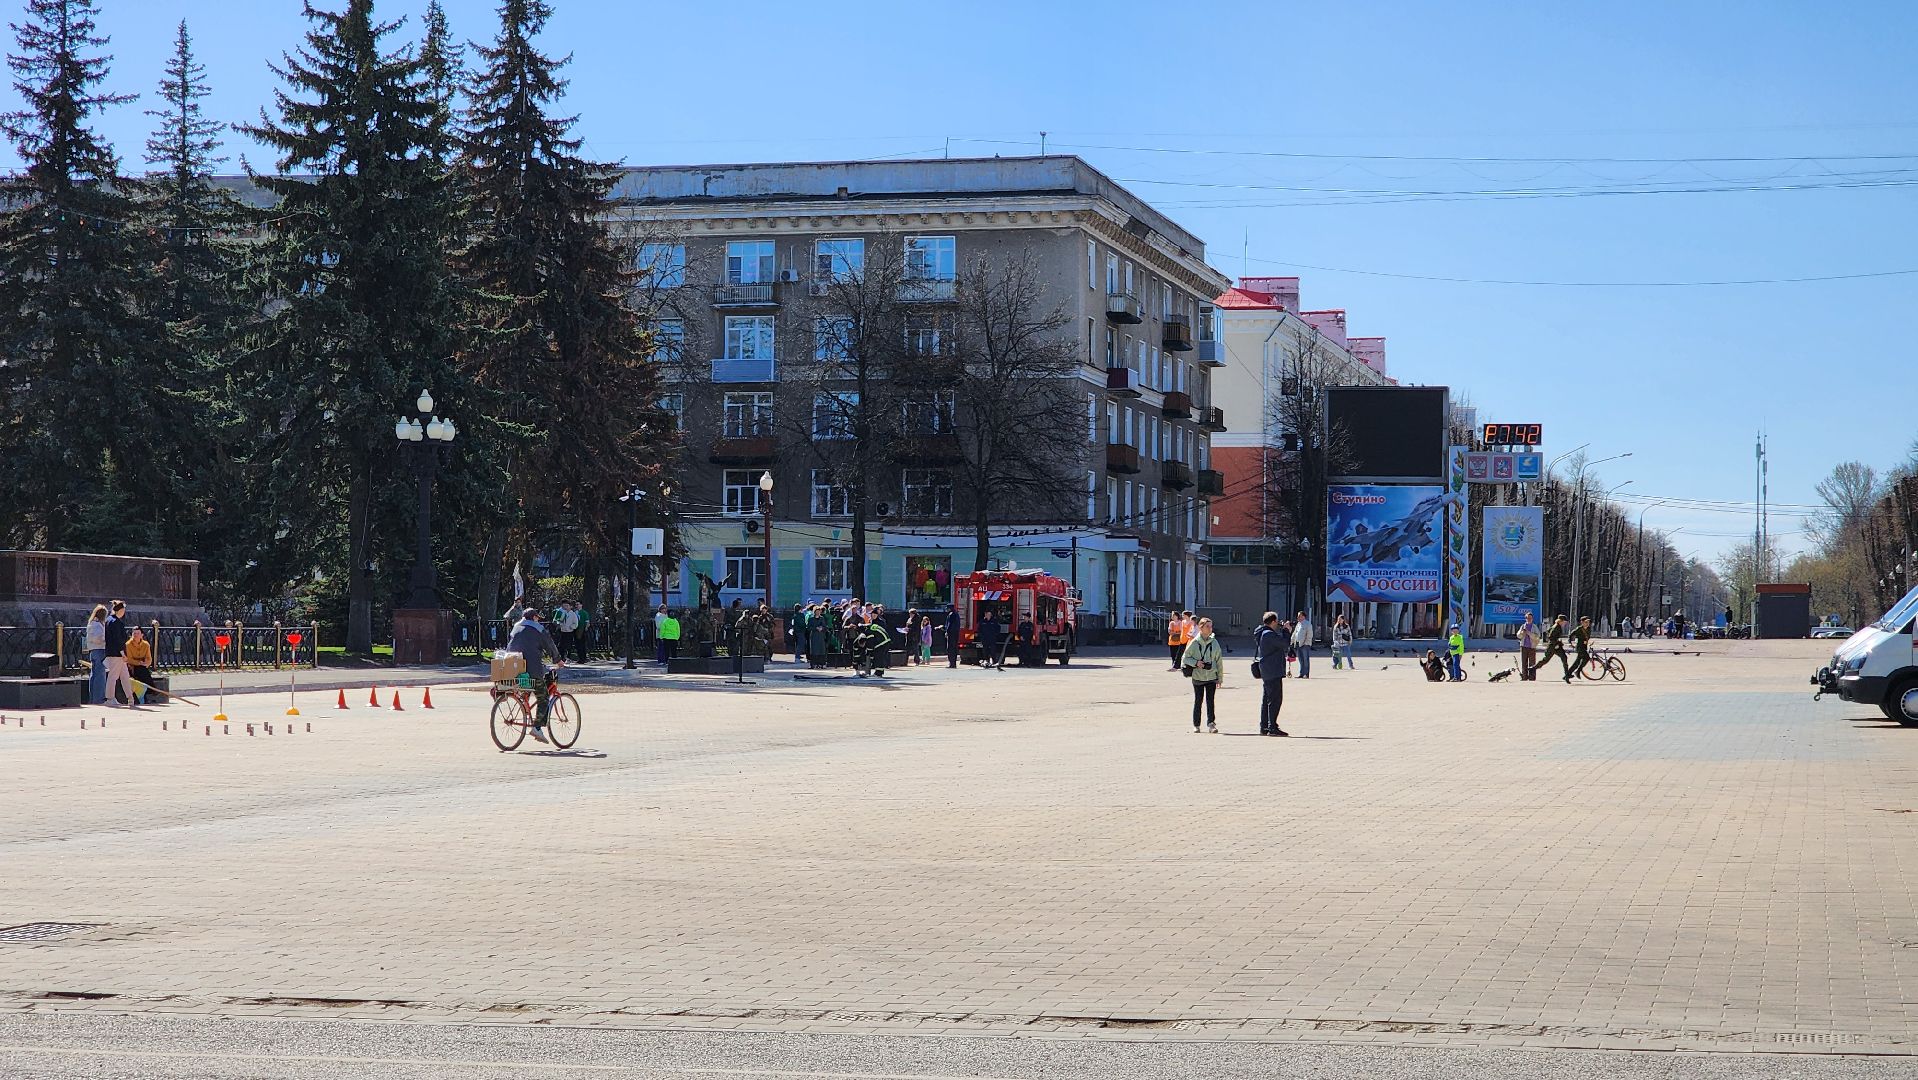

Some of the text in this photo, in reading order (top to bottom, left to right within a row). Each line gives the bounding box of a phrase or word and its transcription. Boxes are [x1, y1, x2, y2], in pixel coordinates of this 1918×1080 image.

[1333, 492, 1386, 505] Ступино
[1331, 569, 1438, 577] центр авиастроения
[1367, 579, 1438, 591] РОССИИ
[1493, 605, 1518, 614] 1507
